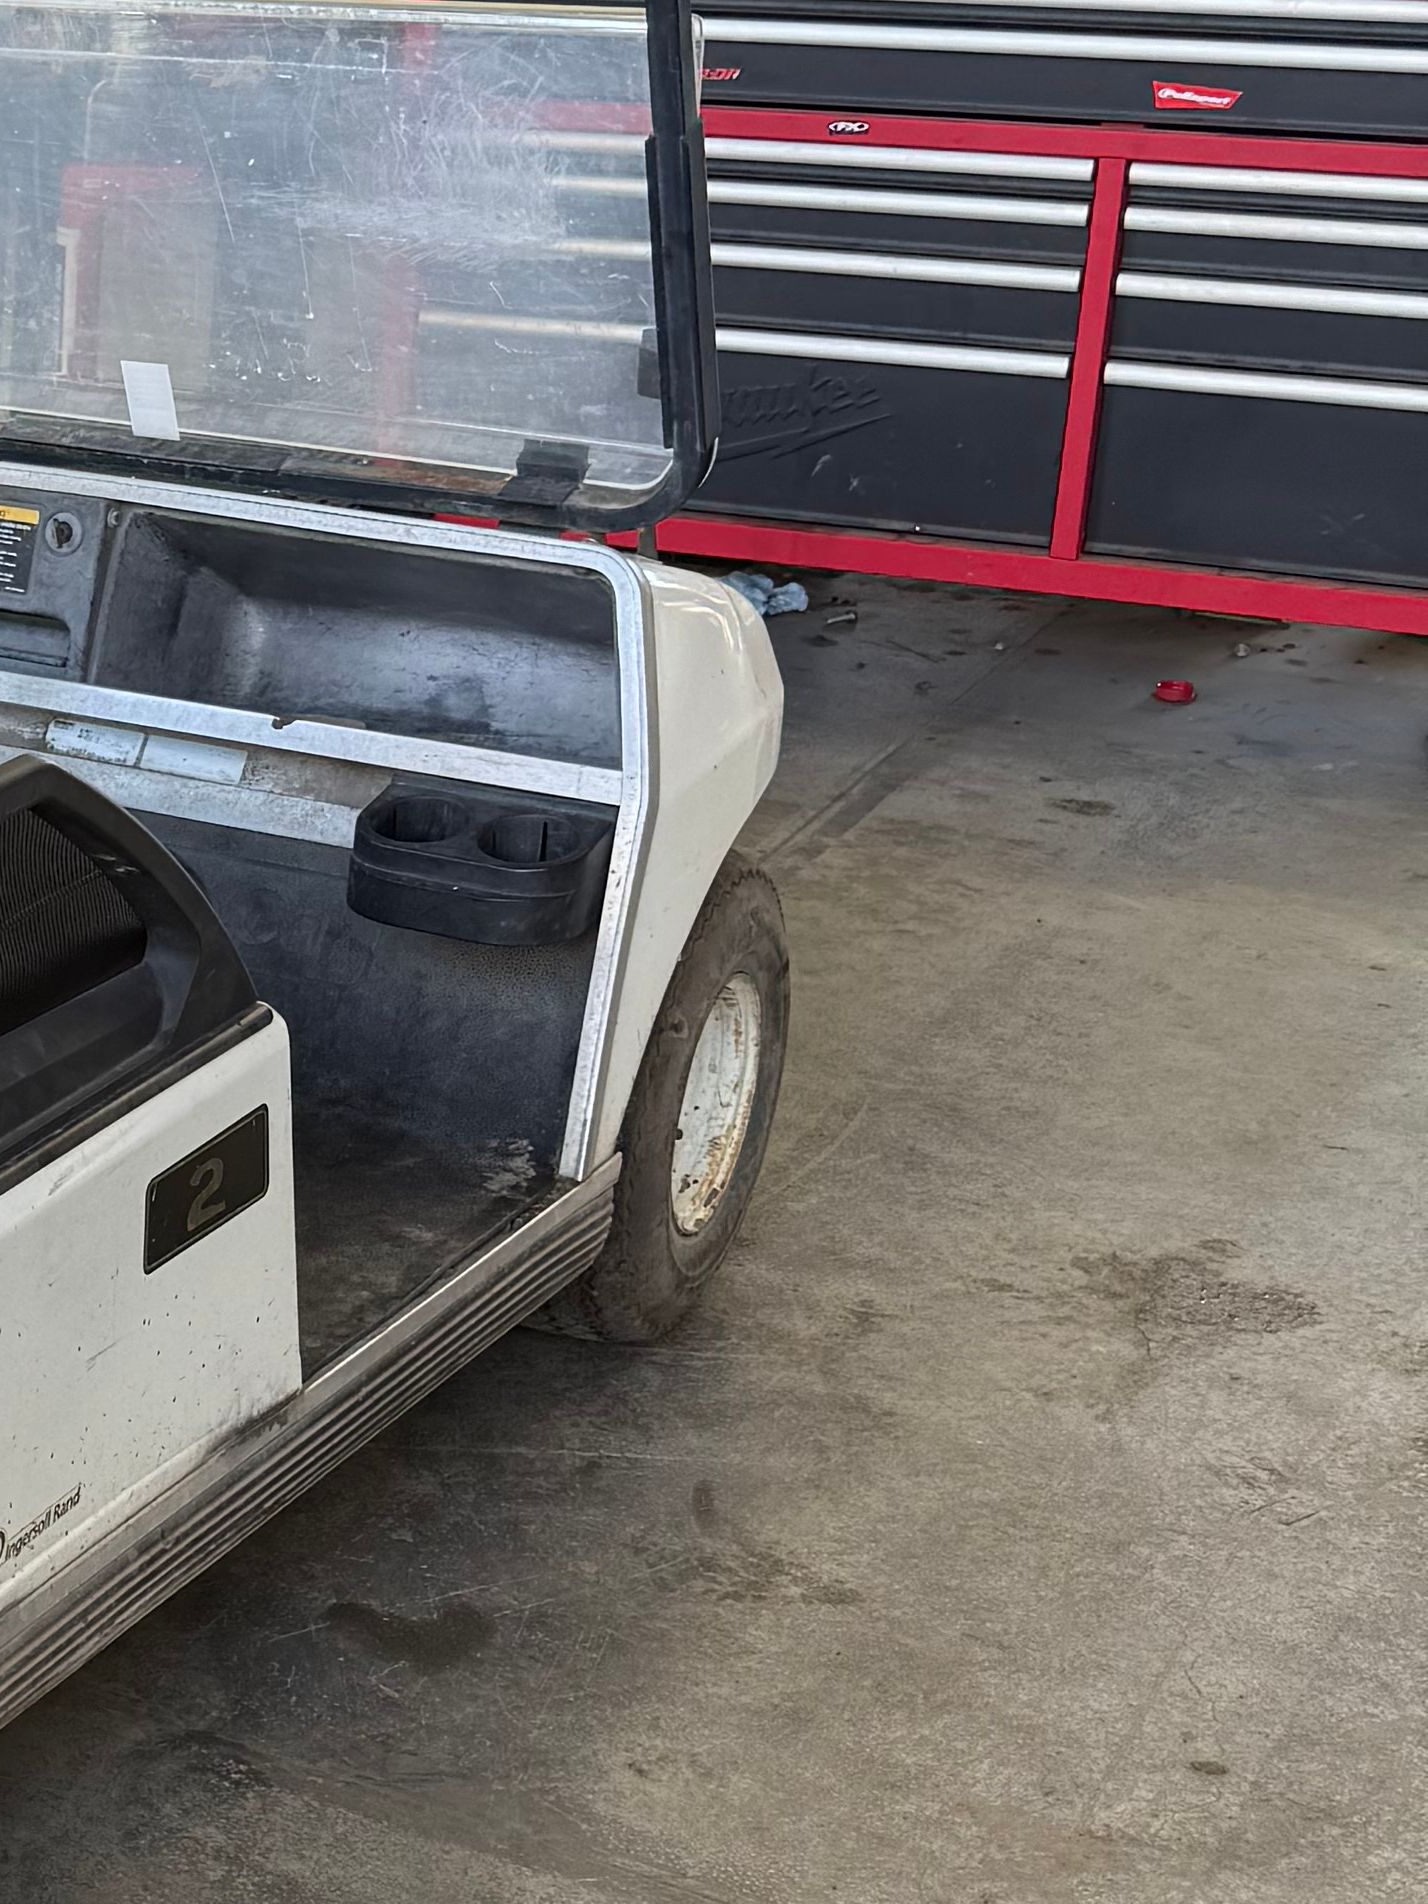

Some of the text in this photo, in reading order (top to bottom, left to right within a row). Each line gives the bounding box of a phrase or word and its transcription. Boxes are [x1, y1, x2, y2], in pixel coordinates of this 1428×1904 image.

[187, 1158, 226, 1232] 2
[5, 1509, 52, 1562] Ingersoll
[53, 1485, 82, 1523] Rand
